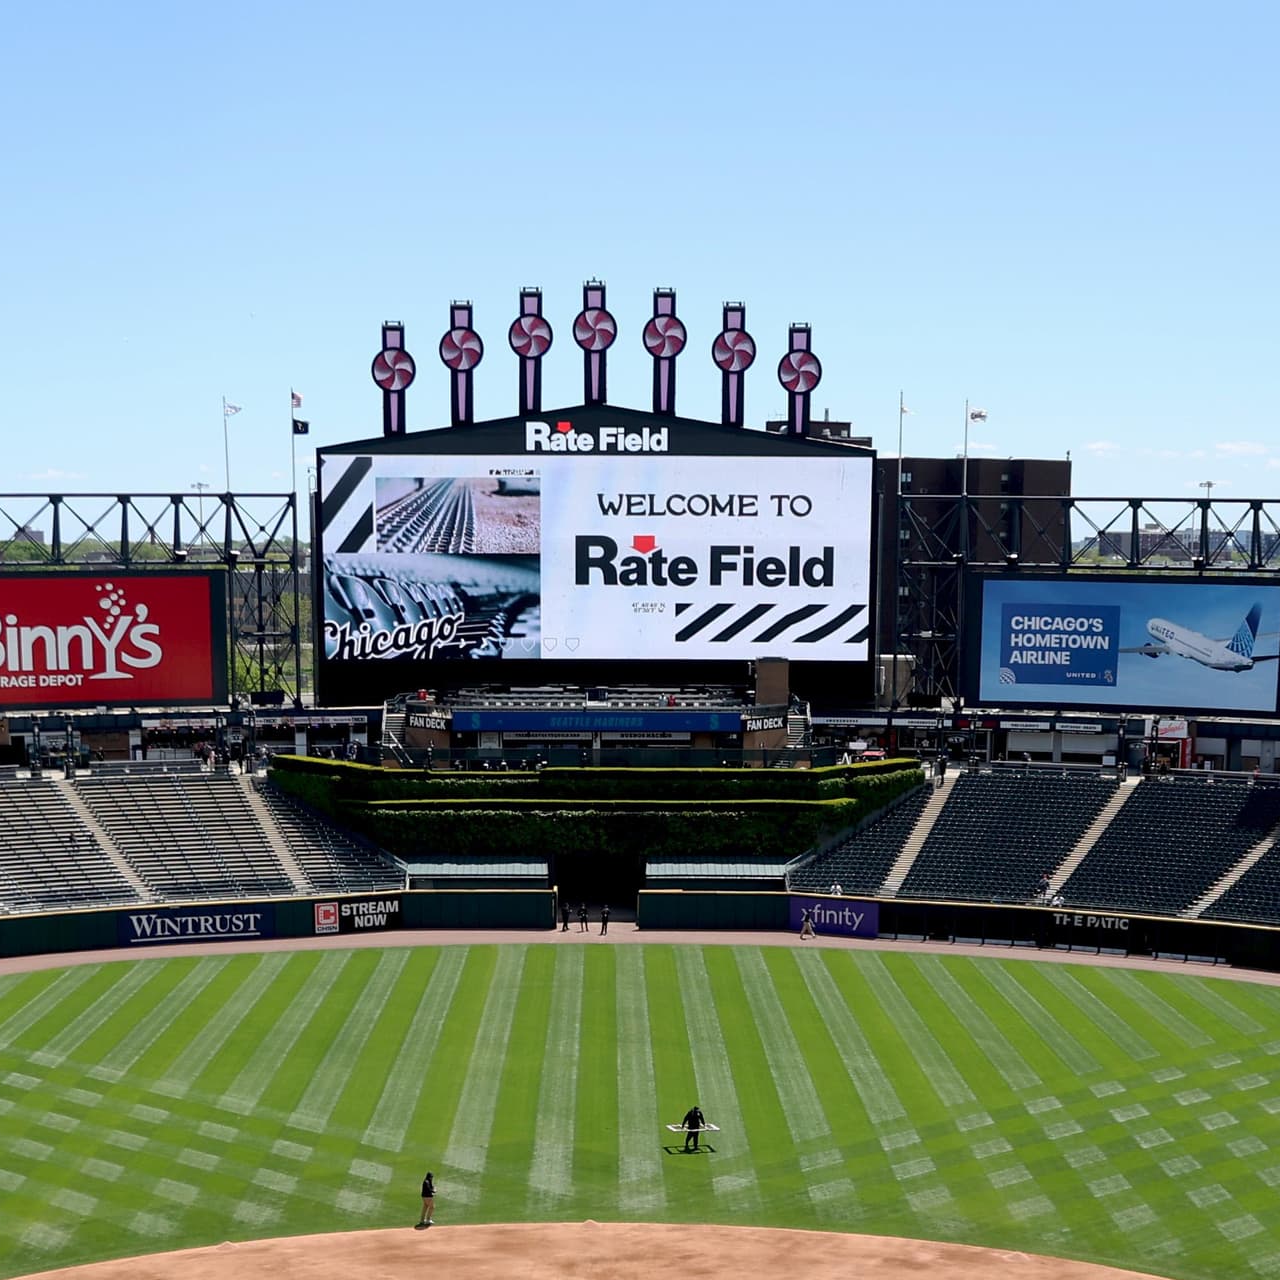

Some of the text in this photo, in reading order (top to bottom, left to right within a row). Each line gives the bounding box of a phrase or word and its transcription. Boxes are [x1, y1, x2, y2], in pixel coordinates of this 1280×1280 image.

[525, 421, 668, 452] Rate Field
[597, 493, 813, 518] WELCOME TO
[574, 534, 835, 587] Rate Field
[1010, 616, 1103, 633] CHICAGO'S
[1010, 633, 1109, 650] HOMETOWN
[1009, 651, 1070, 665] AIRLINE
[39, 674, 84, 687] DEPOT
[1066, 671, 1097, 679] UNITED
[409, 715, 446, 731] FAN DECK
[746, 716, 783, 731] FAN DECK
[341, 900, 399, 916] STREAM
[129, 913, 262, 937] WINTRUST
[354, 914, 387, 928] NOW
